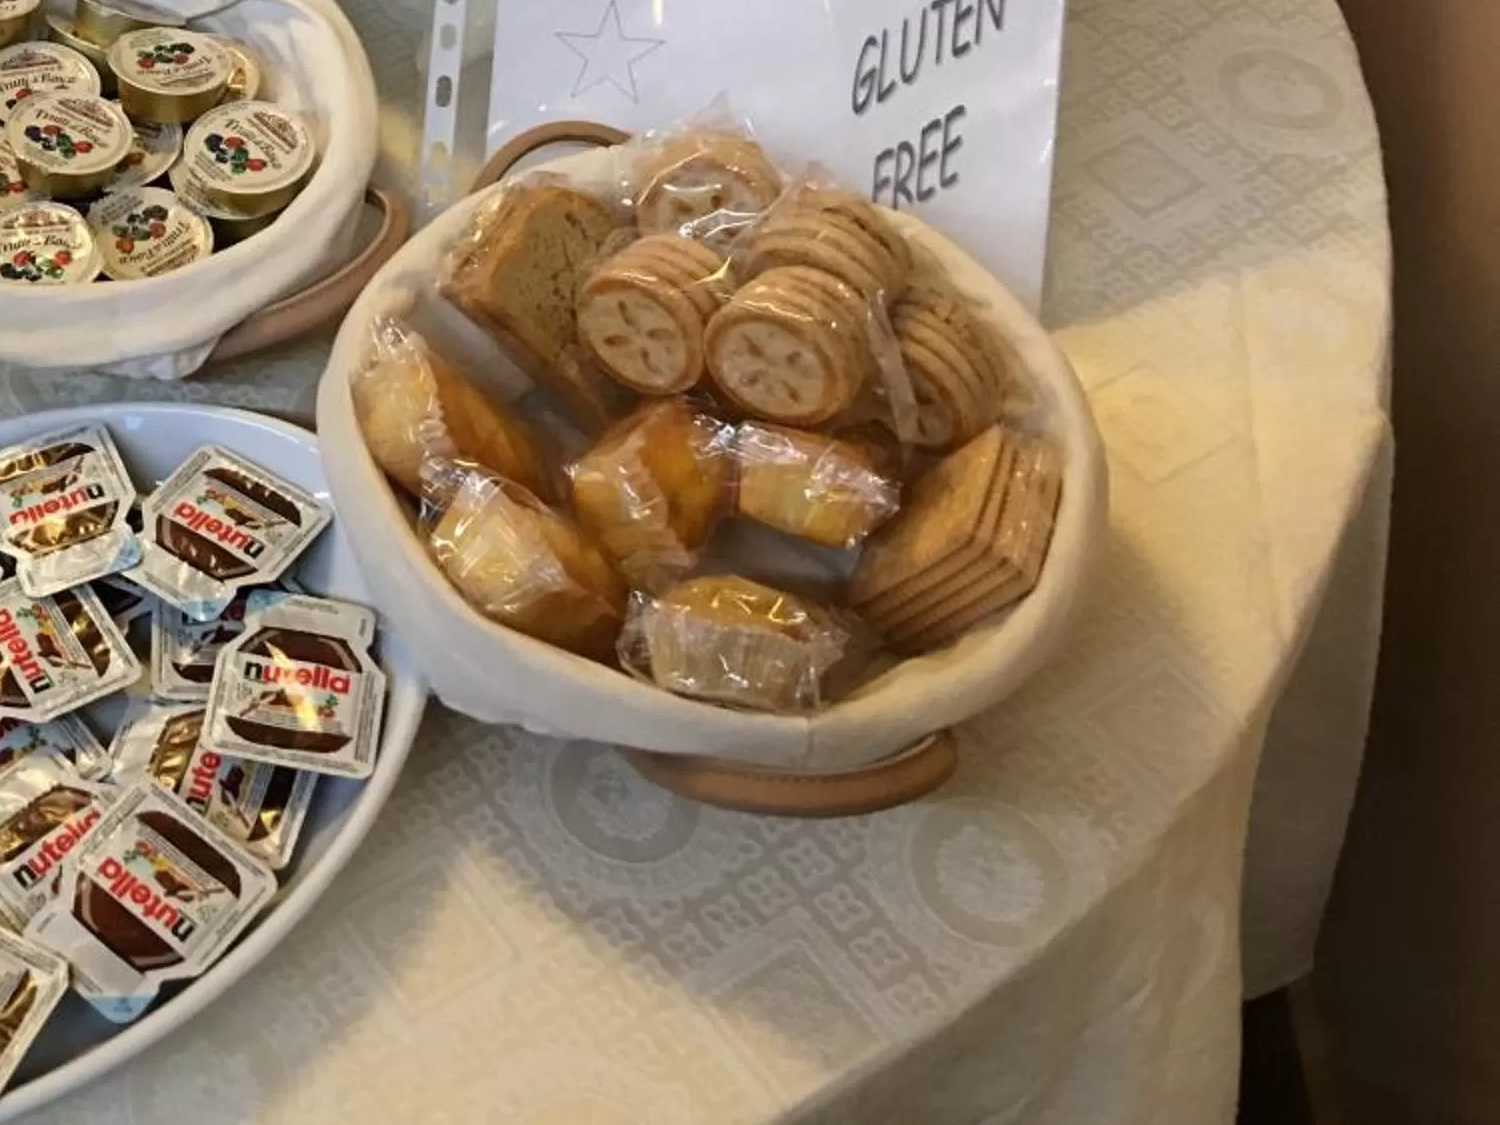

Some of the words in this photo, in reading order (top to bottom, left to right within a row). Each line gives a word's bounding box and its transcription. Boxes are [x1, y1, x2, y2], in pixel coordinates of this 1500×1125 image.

[871, 104, 966, 206] FREE
[9, 483, 105, 528] nutella
[171, 498, 265, 560] nutella
[99, 855, 198, 944] nutella
